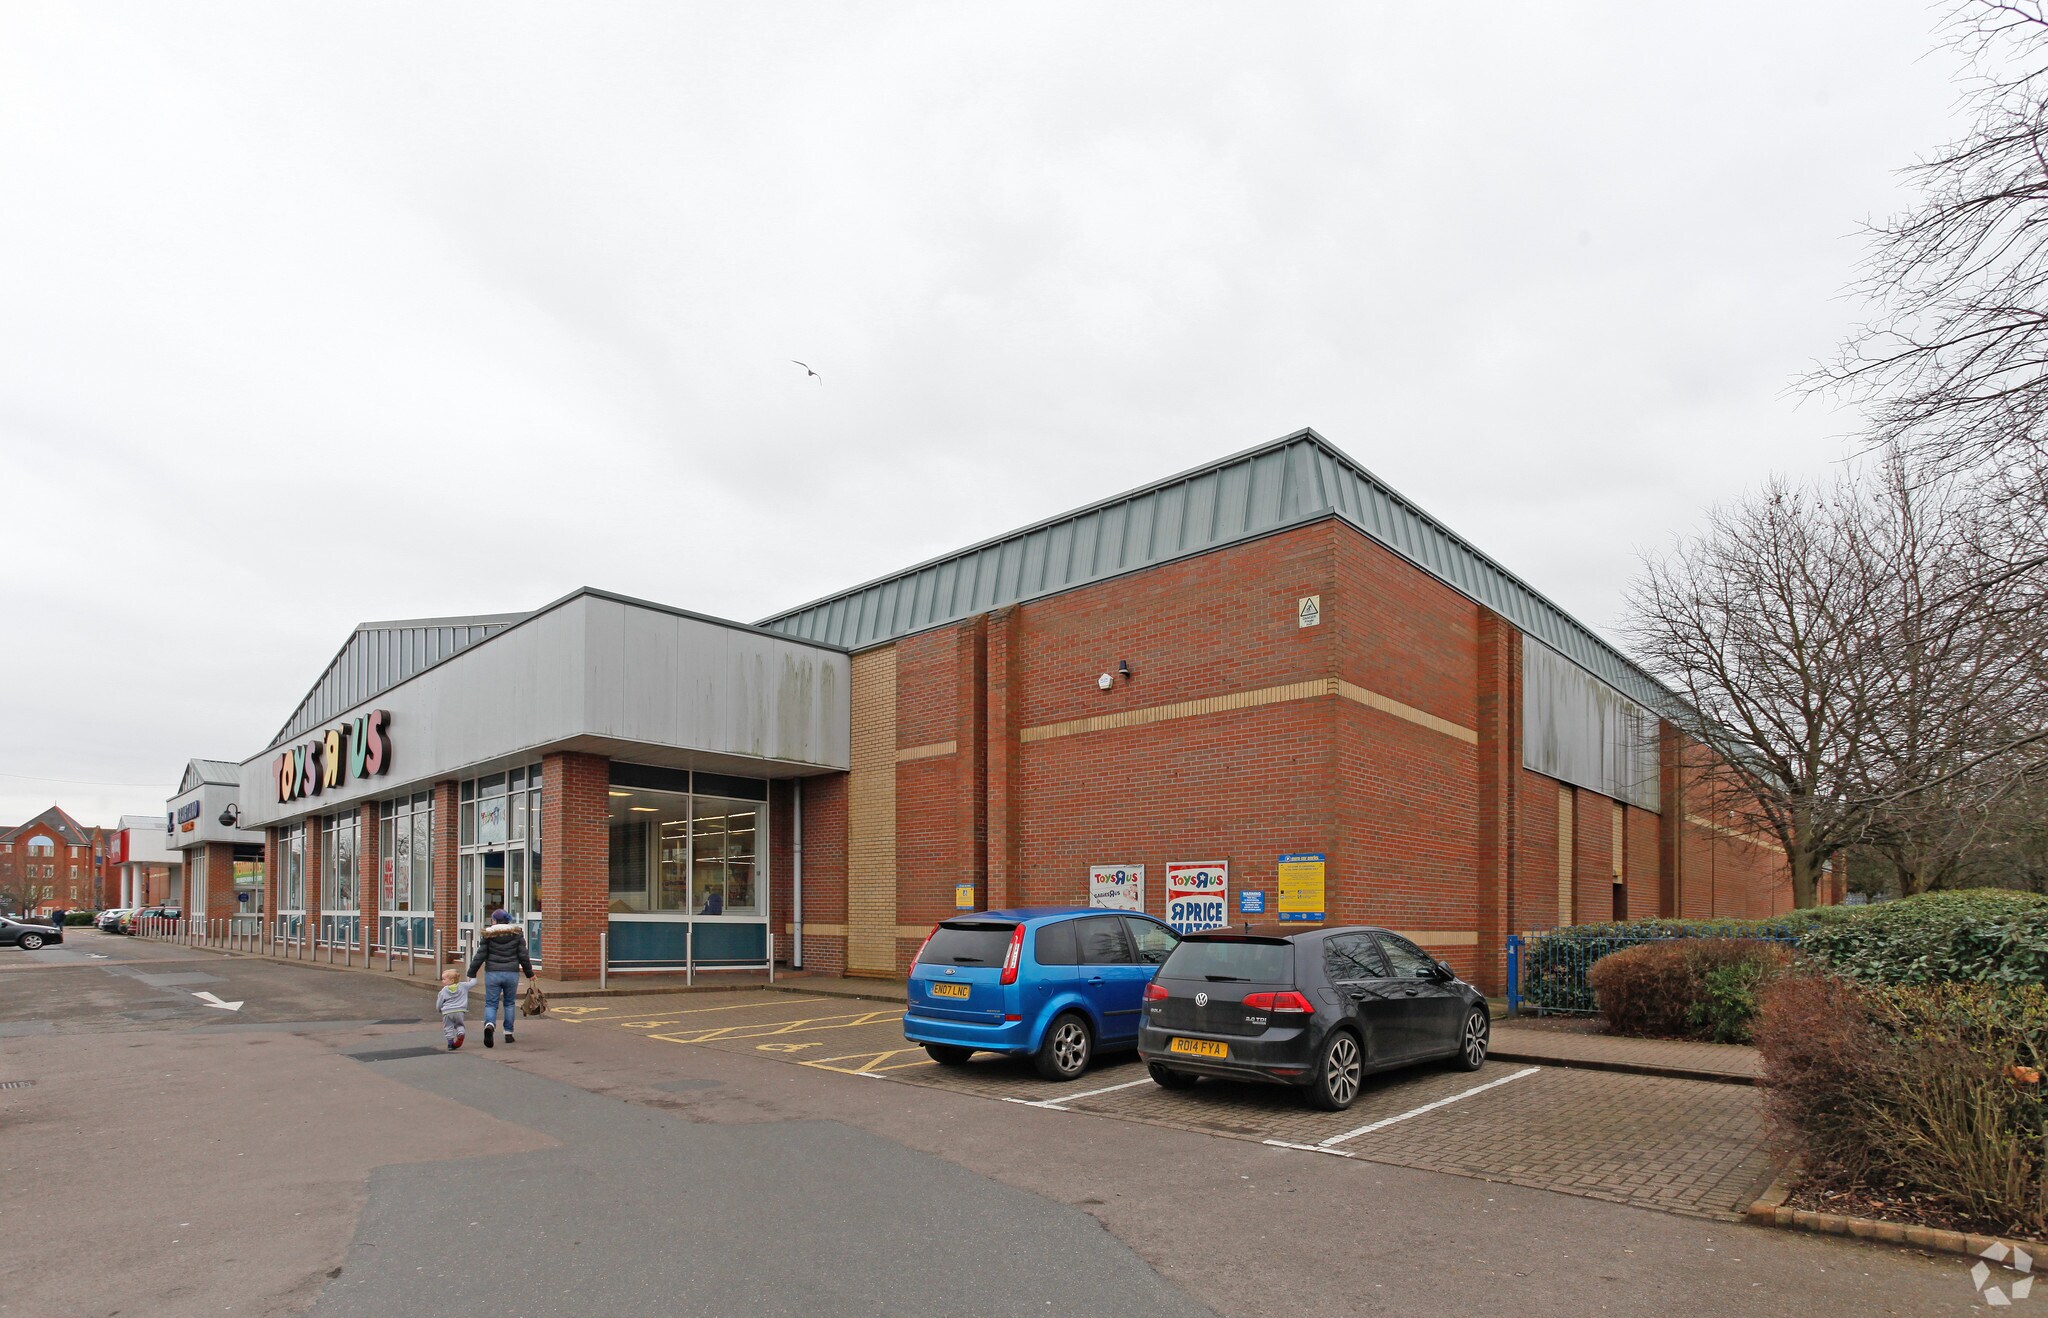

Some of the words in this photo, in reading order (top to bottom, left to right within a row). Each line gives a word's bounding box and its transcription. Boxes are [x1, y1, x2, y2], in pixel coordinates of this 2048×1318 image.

[273, 740, 323, 803] TOYS
[351, 709, 391, 778] US
[1186, 902, 1222, 921] PRICE
[953, 986, 967, 996] LNC
[1200, 1042, 1220, 1054] FYA
